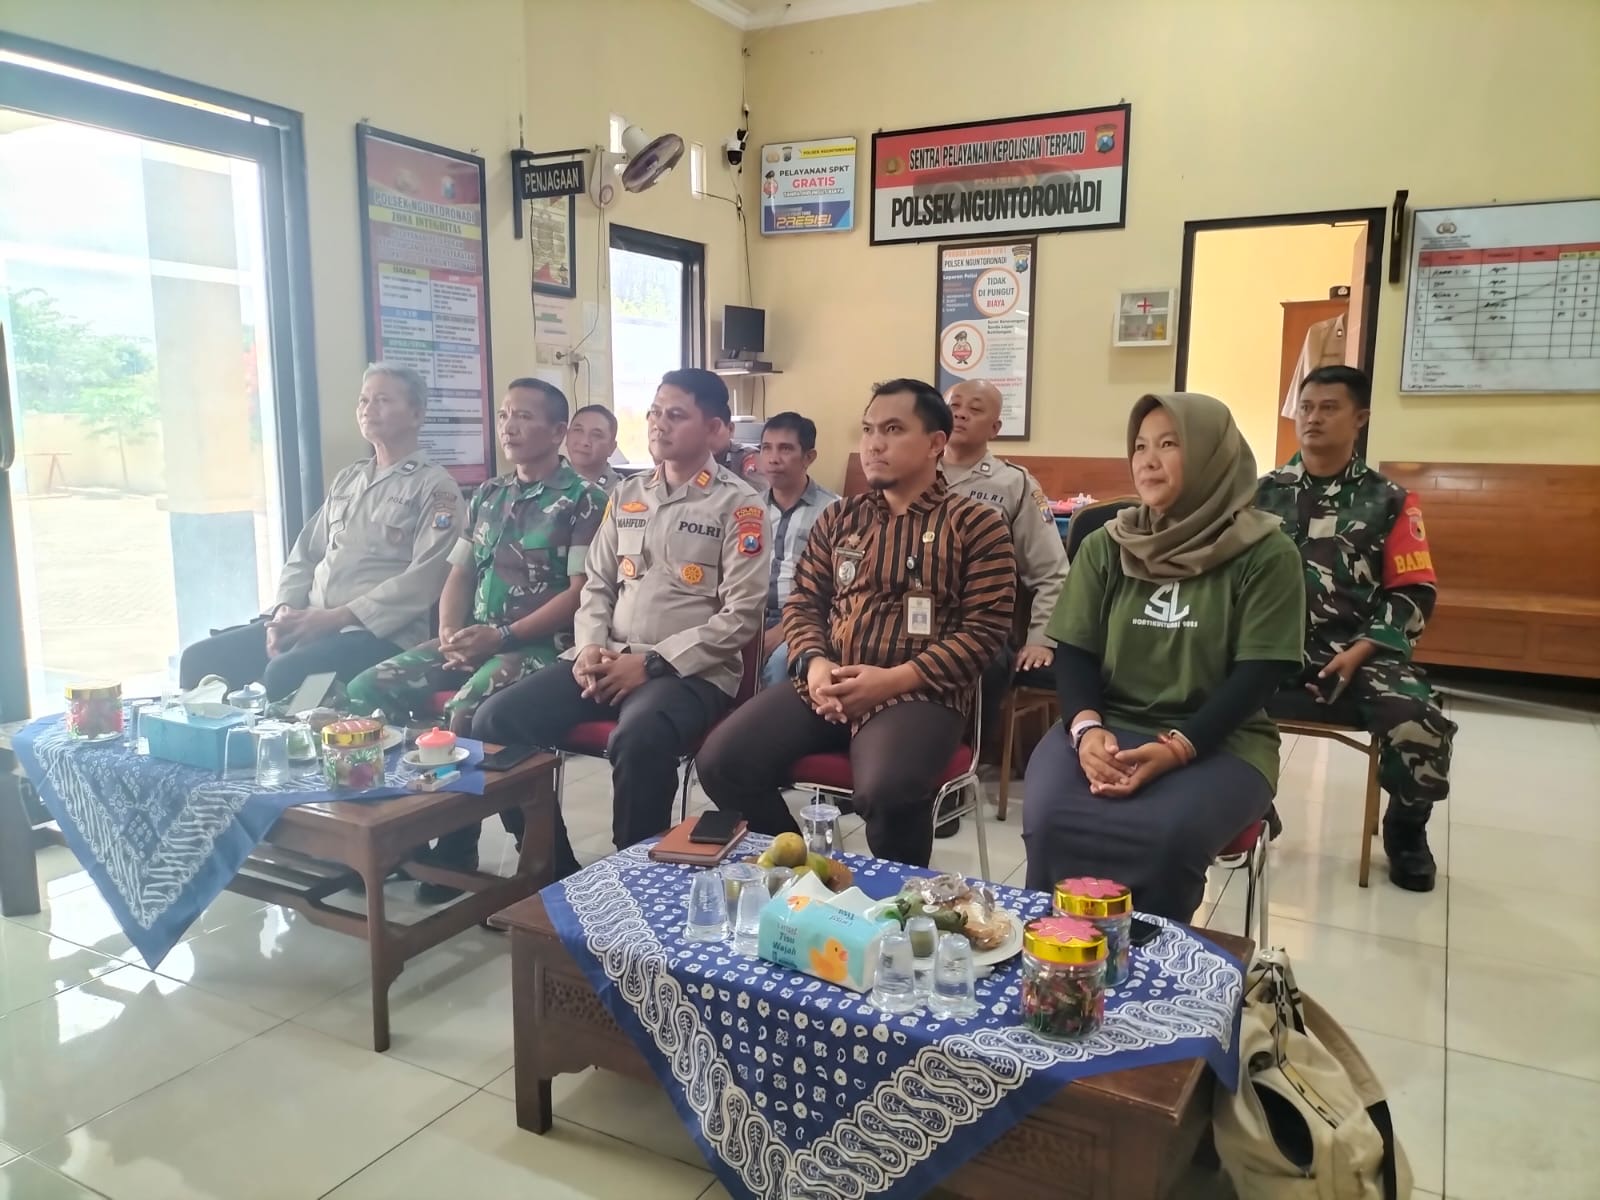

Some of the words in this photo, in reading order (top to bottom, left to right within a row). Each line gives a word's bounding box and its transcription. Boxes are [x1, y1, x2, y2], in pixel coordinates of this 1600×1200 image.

[909, 147, 940, 171] SENTRA
[942, 140, 991, 167] PELAYANAN
[991, 135, 1042, 162] KEPOLISIAN
[1045, 131, 1086, 157] TERPADU
[780, 167, 827, 177] PELAYANAN
[829, 165, 850, 173] SPKT
[525, 167, 579, 193] PENJAGAAN
[792, 176, 836, 189] GRATIS
[891, 192, 955, 227] POLSEK
[960, 180, 1102, 222] NGUNTORONADI
[987, 277, 1006, 286] TIDAK
[978, 289, 986, 297] DI
[987, 287, 1014, 296] PUNGUT
[986, 299, 1005, 308] BIAYA
[970, 490, 1004, 503] POLRI
[678, 521, 721, 538] POLRI
